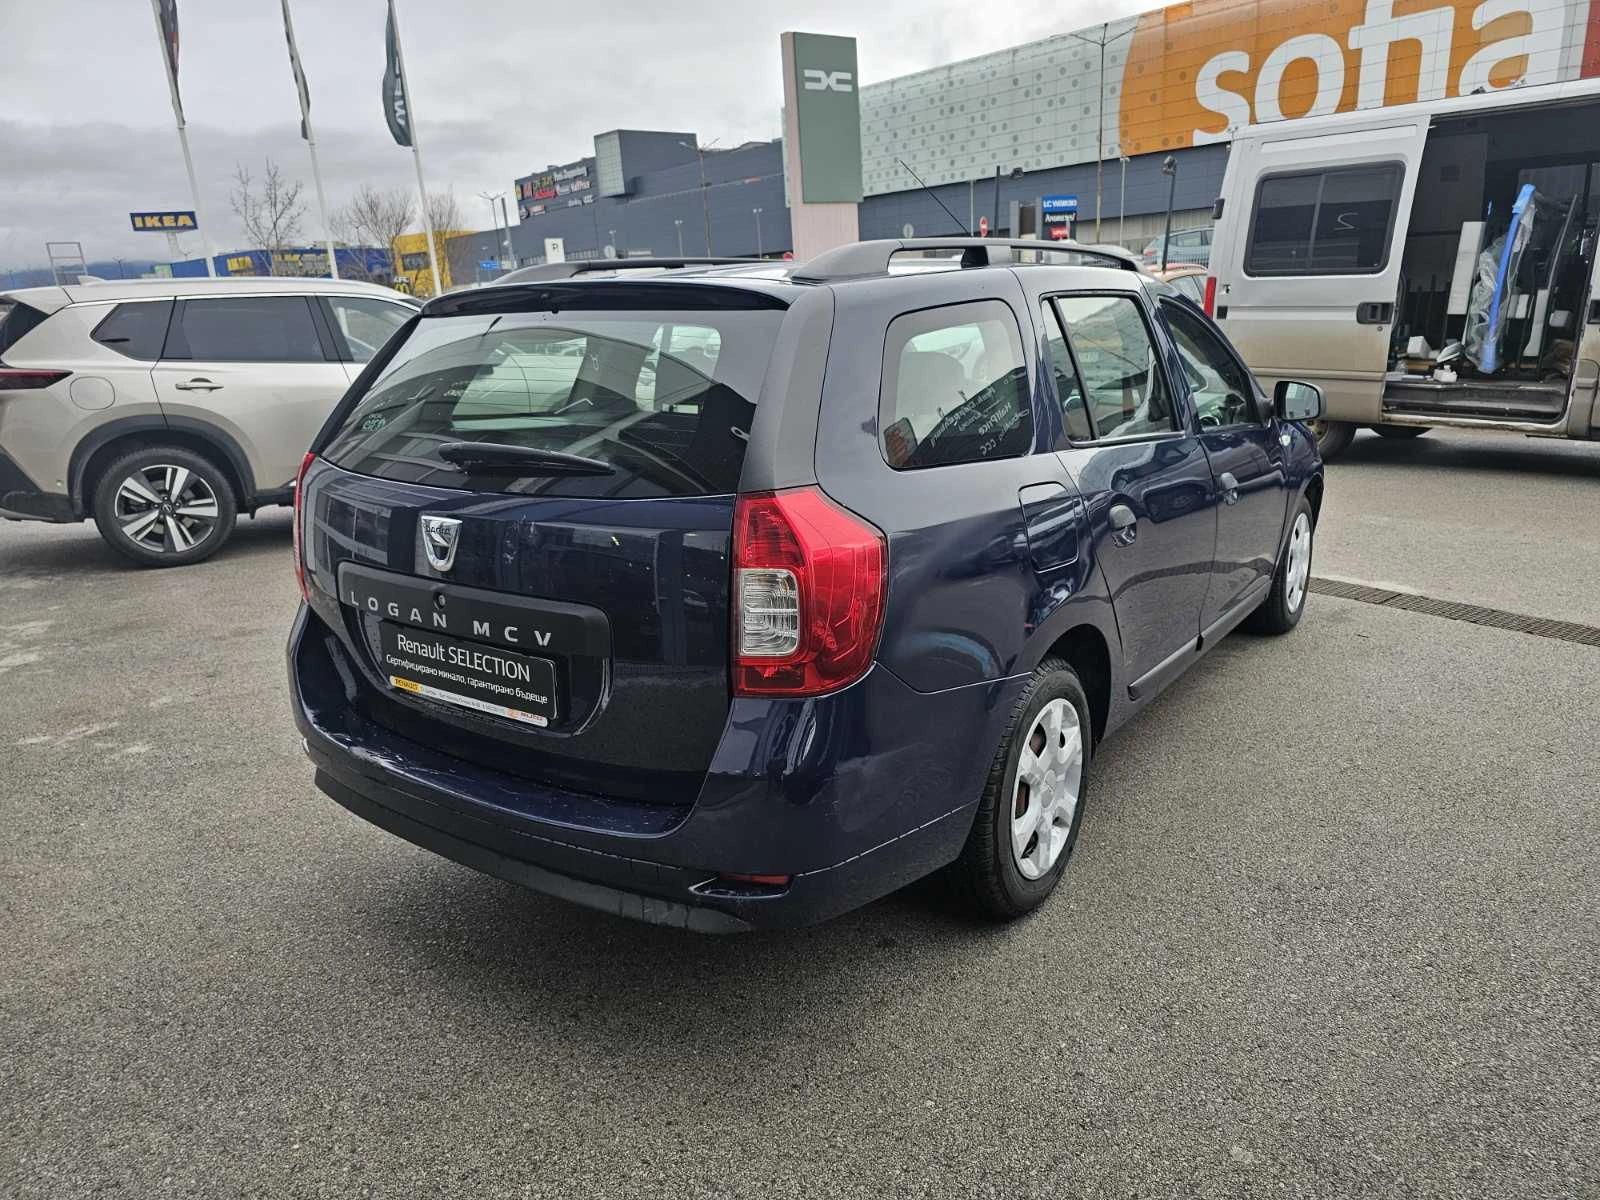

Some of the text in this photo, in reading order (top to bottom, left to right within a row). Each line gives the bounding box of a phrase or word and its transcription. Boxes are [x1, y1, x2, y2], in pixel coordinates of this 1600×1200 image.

[134, 215, 194, 228] IKEA
[351, 592, 551, 646] LOGAN MCV
[386, 655, 437, 676] Сертифицирано
[467, 676, 515, 696] гарантирано
[515, 688, 548, 704] бъдеще
[397, 633, 531, 682] Renault SELECTION
